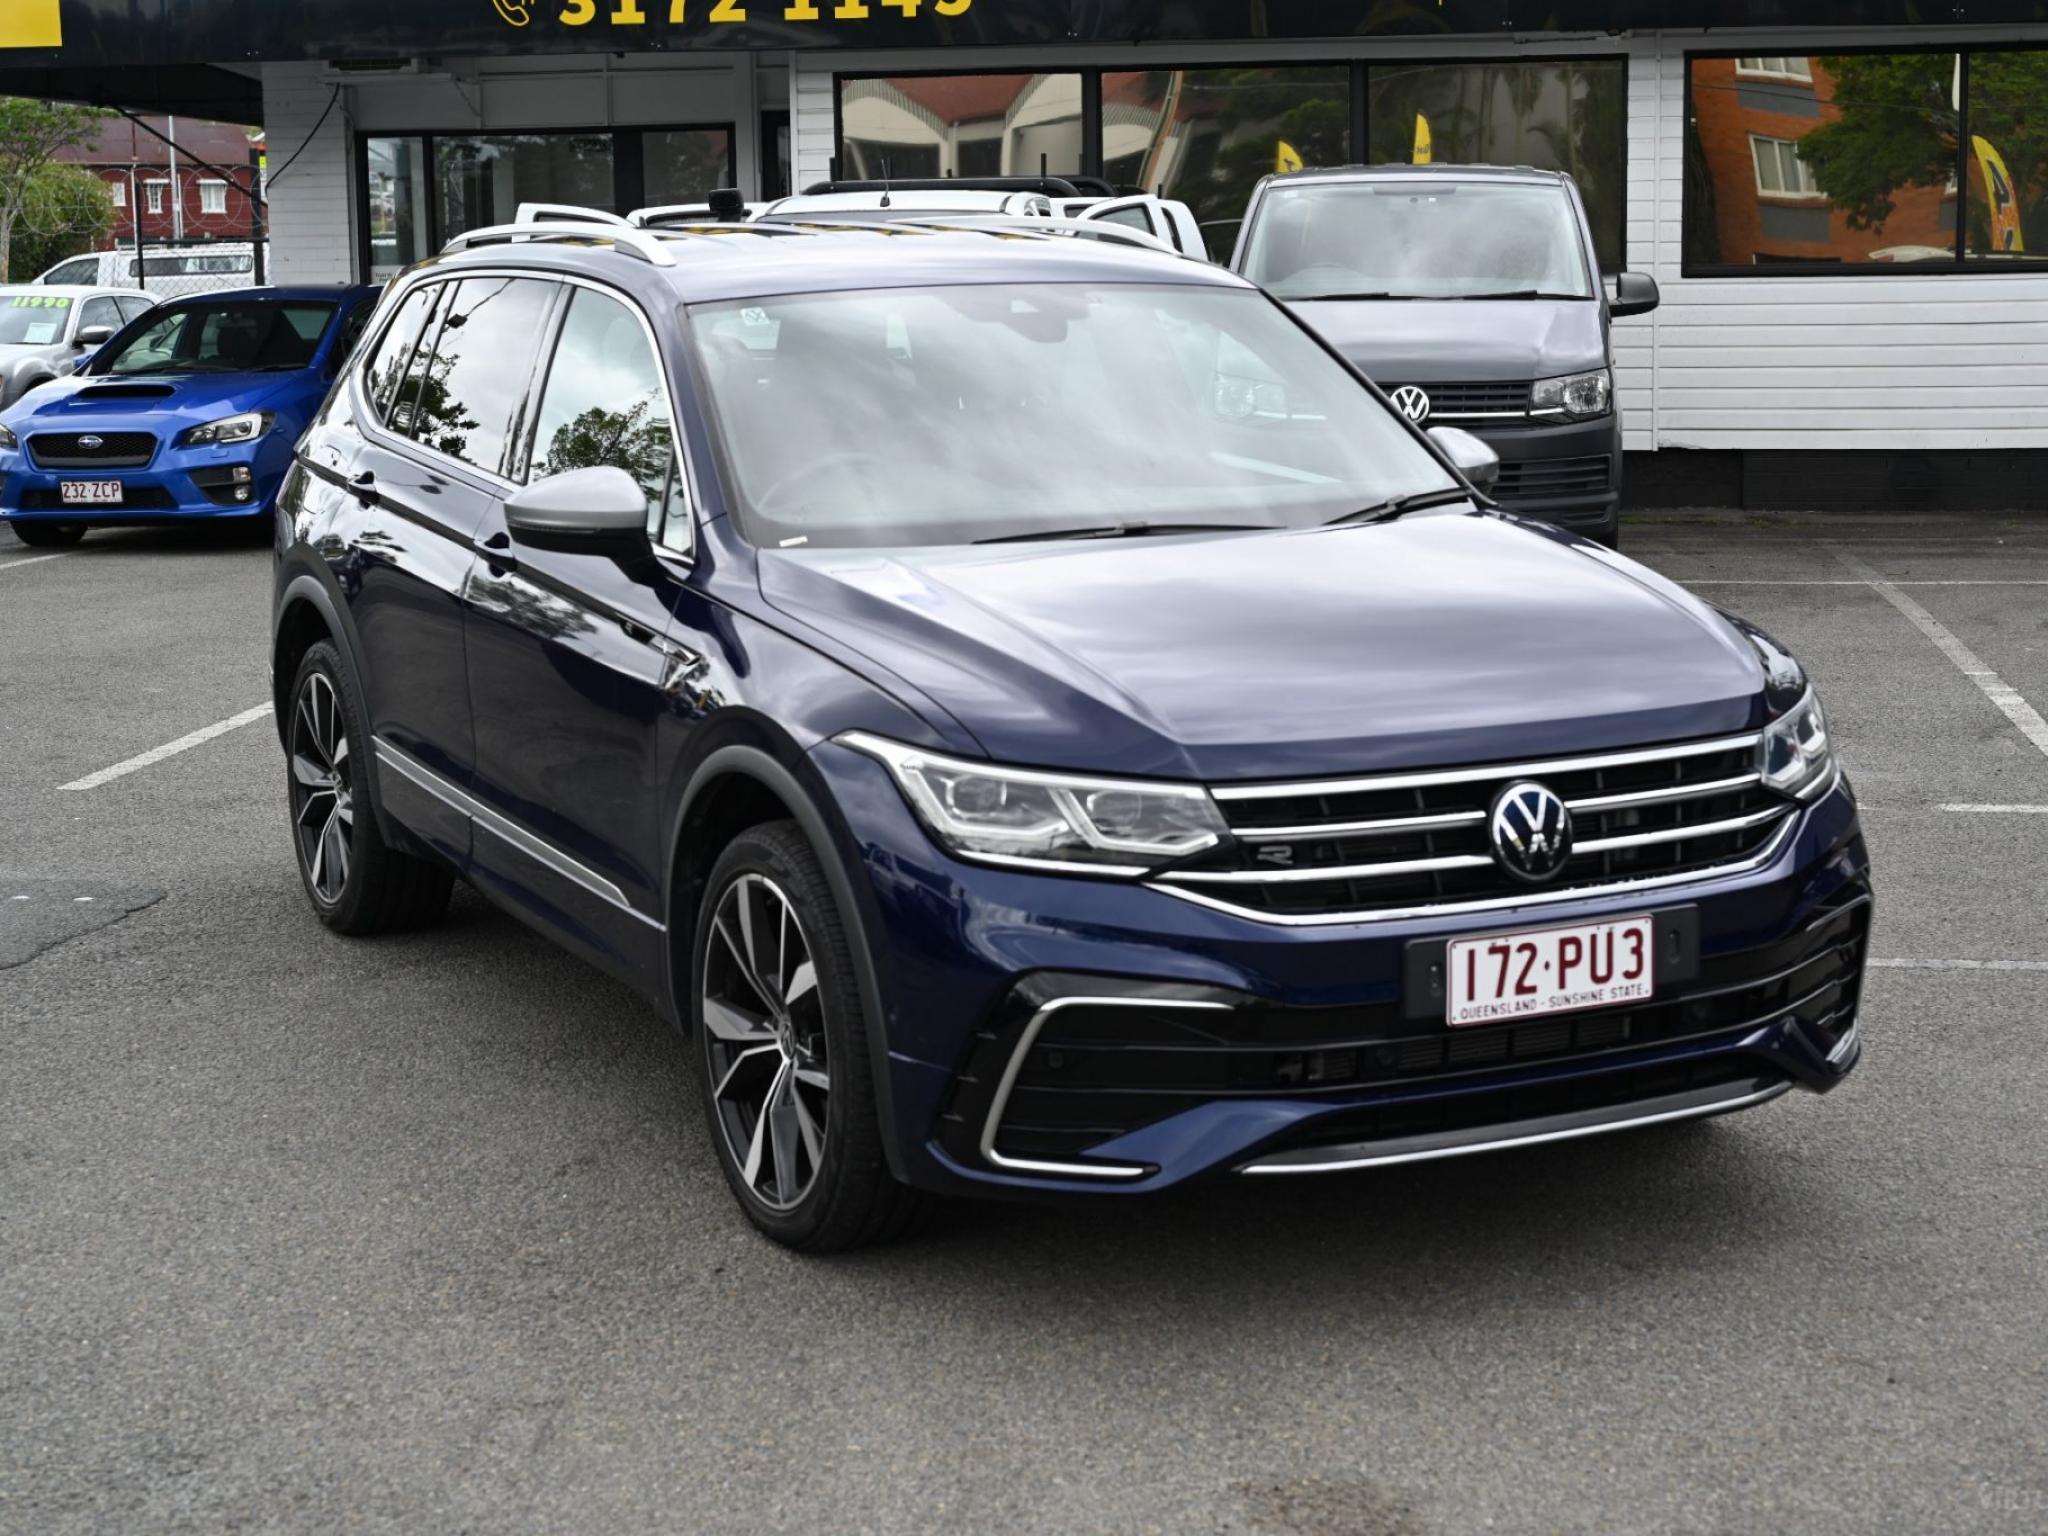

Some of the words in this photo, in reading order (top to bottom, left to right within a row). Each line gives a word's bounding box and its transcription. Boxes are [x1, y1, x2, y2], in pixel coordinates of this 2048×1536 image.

[784, 0, 973, 21] 114
[10, 295, 70, 309] 11990
[1460, 998, 1537, 1020] QUEENSLAND
[1548, 988, 1605, 1008] SUNSHINE
[1610, 982, 1643, 999] STATE
